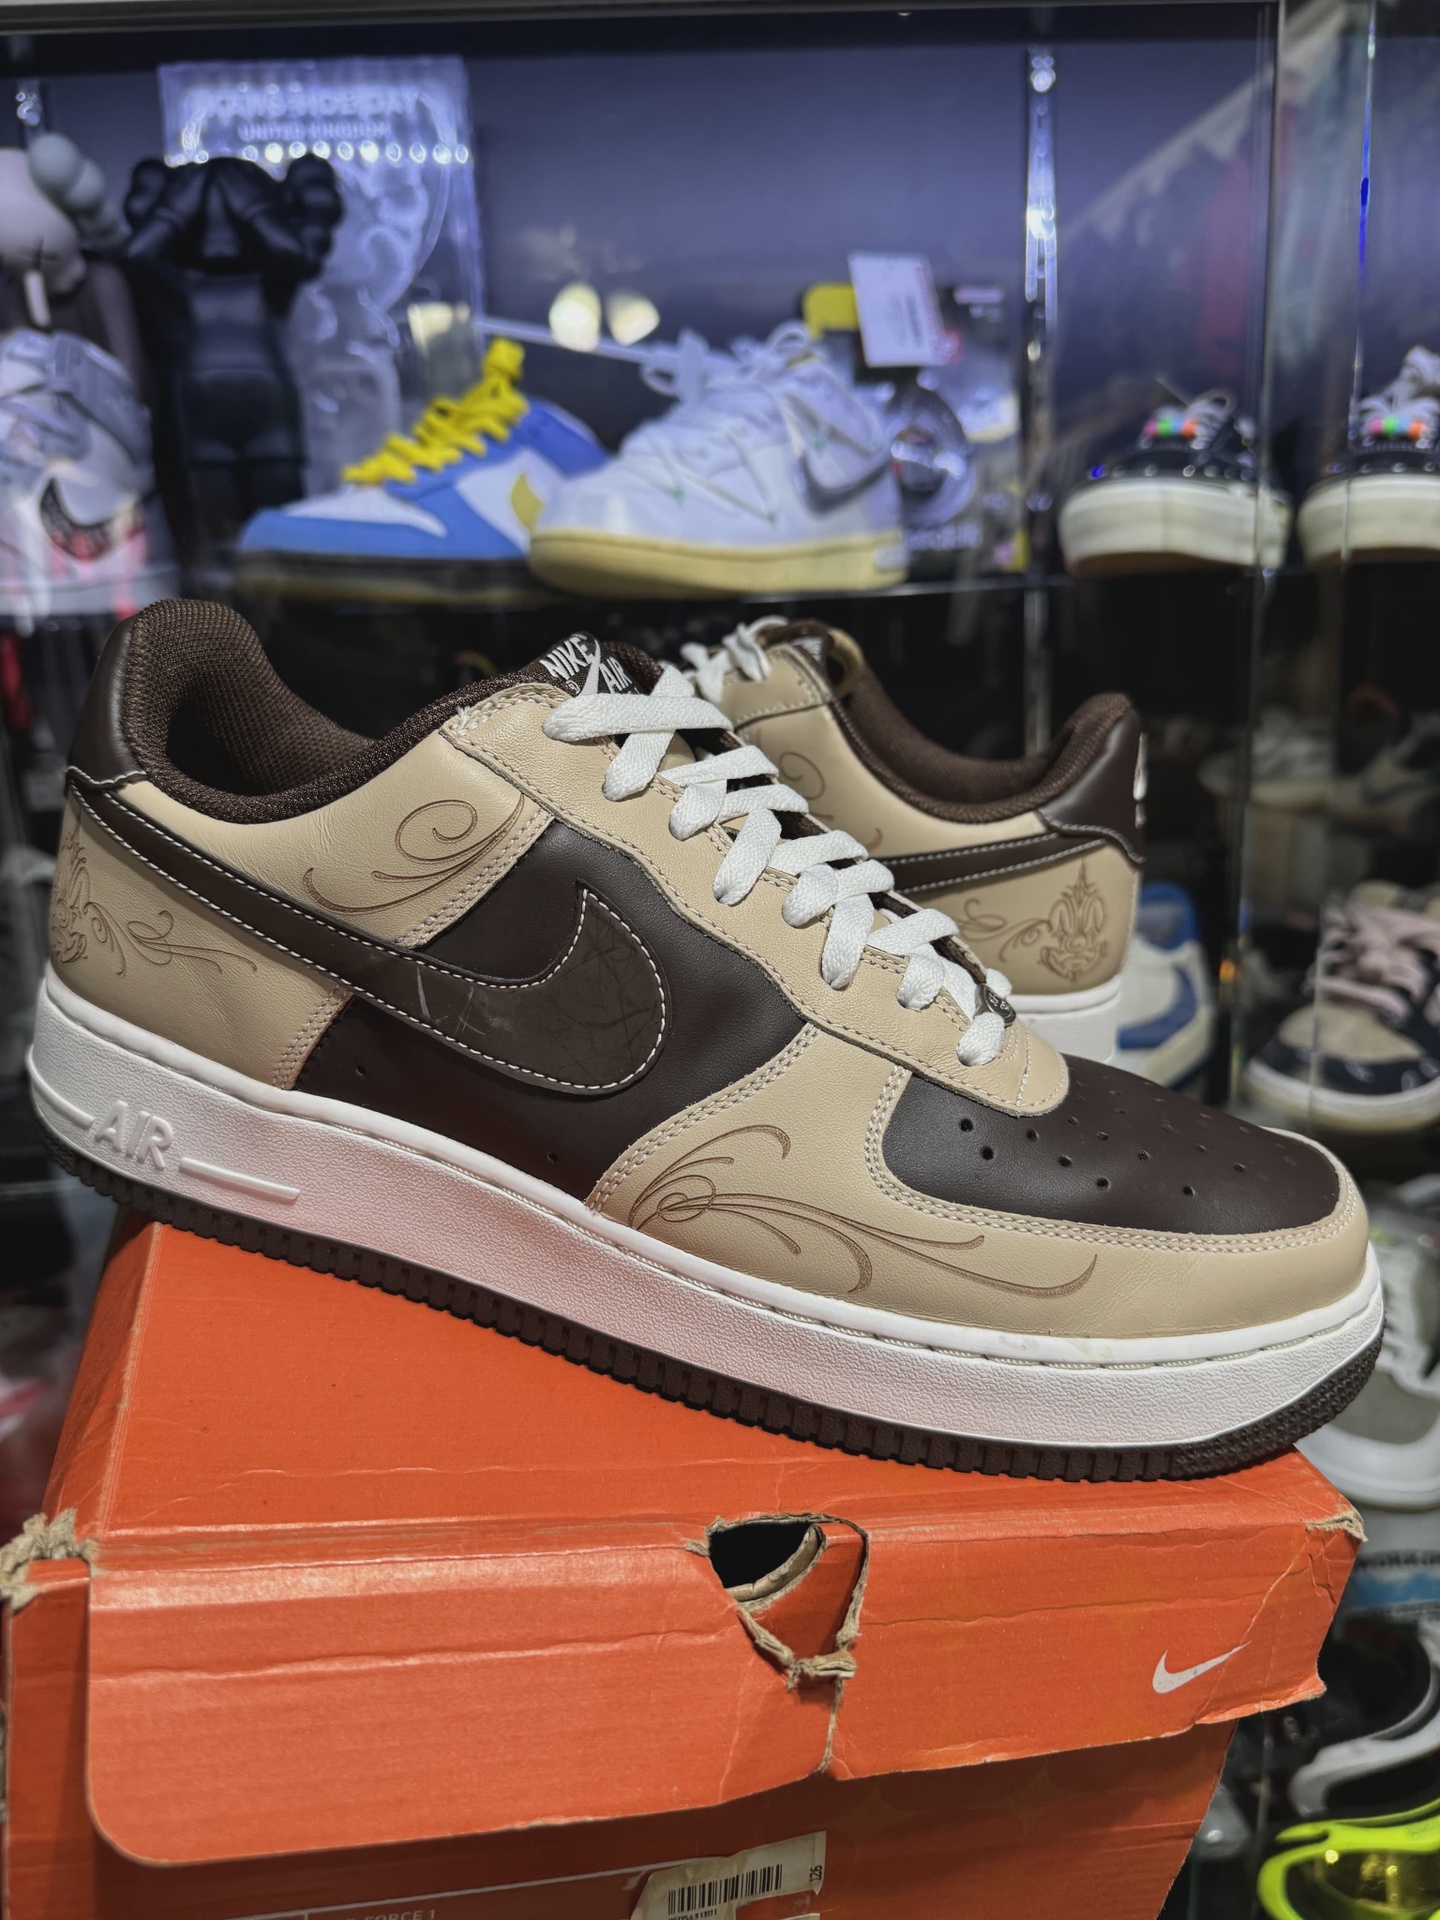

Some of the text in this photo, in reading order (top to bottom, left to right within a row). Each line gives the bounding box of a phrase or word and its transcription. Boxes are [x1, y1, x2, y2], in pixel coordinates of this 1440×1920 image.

[539, 633, 592, 680] NIKE
[600, 657, 633, 694] AIR
[95, 1100, 174, 1171] AIR
